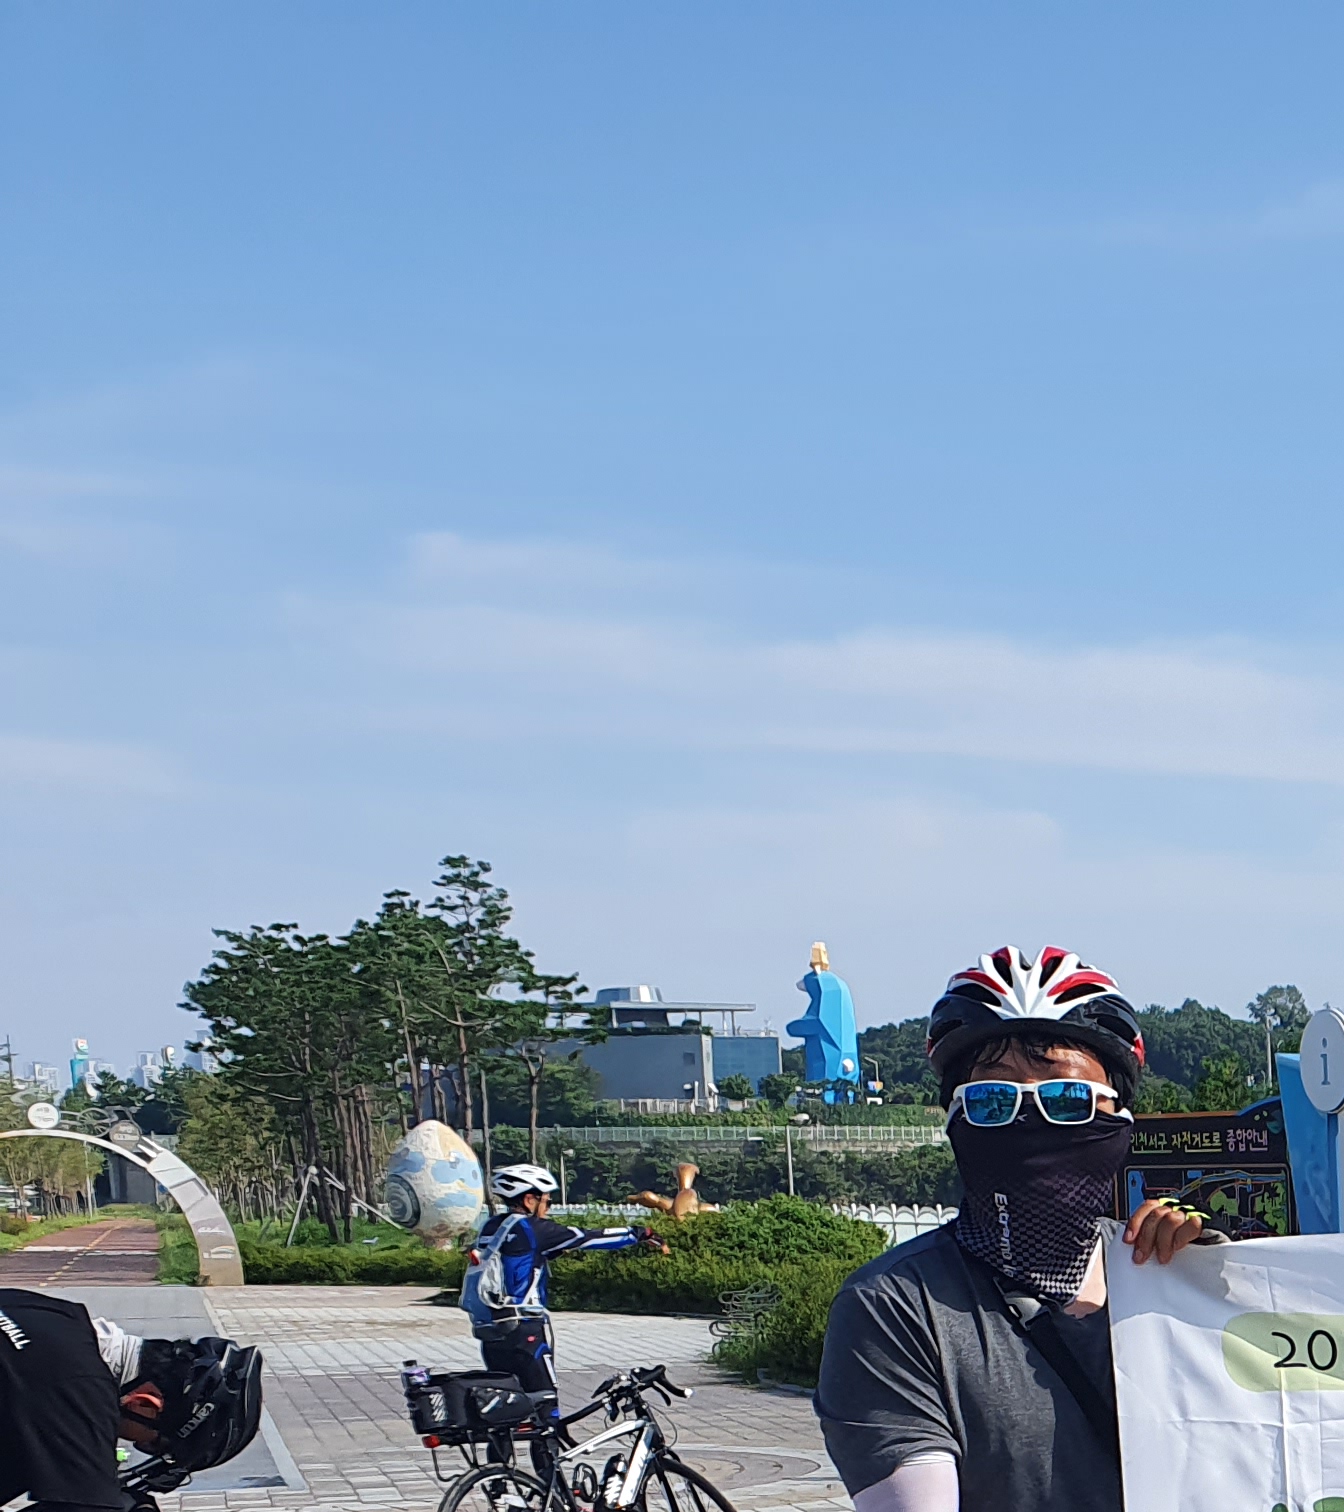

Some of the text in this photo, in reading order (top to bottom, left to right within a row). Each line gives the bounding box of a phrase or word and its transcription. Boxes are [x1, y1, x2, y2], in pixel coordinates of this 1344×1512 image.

[1130, 1128, 1268, 1154] 인천서구 자전거도로 종합안내
